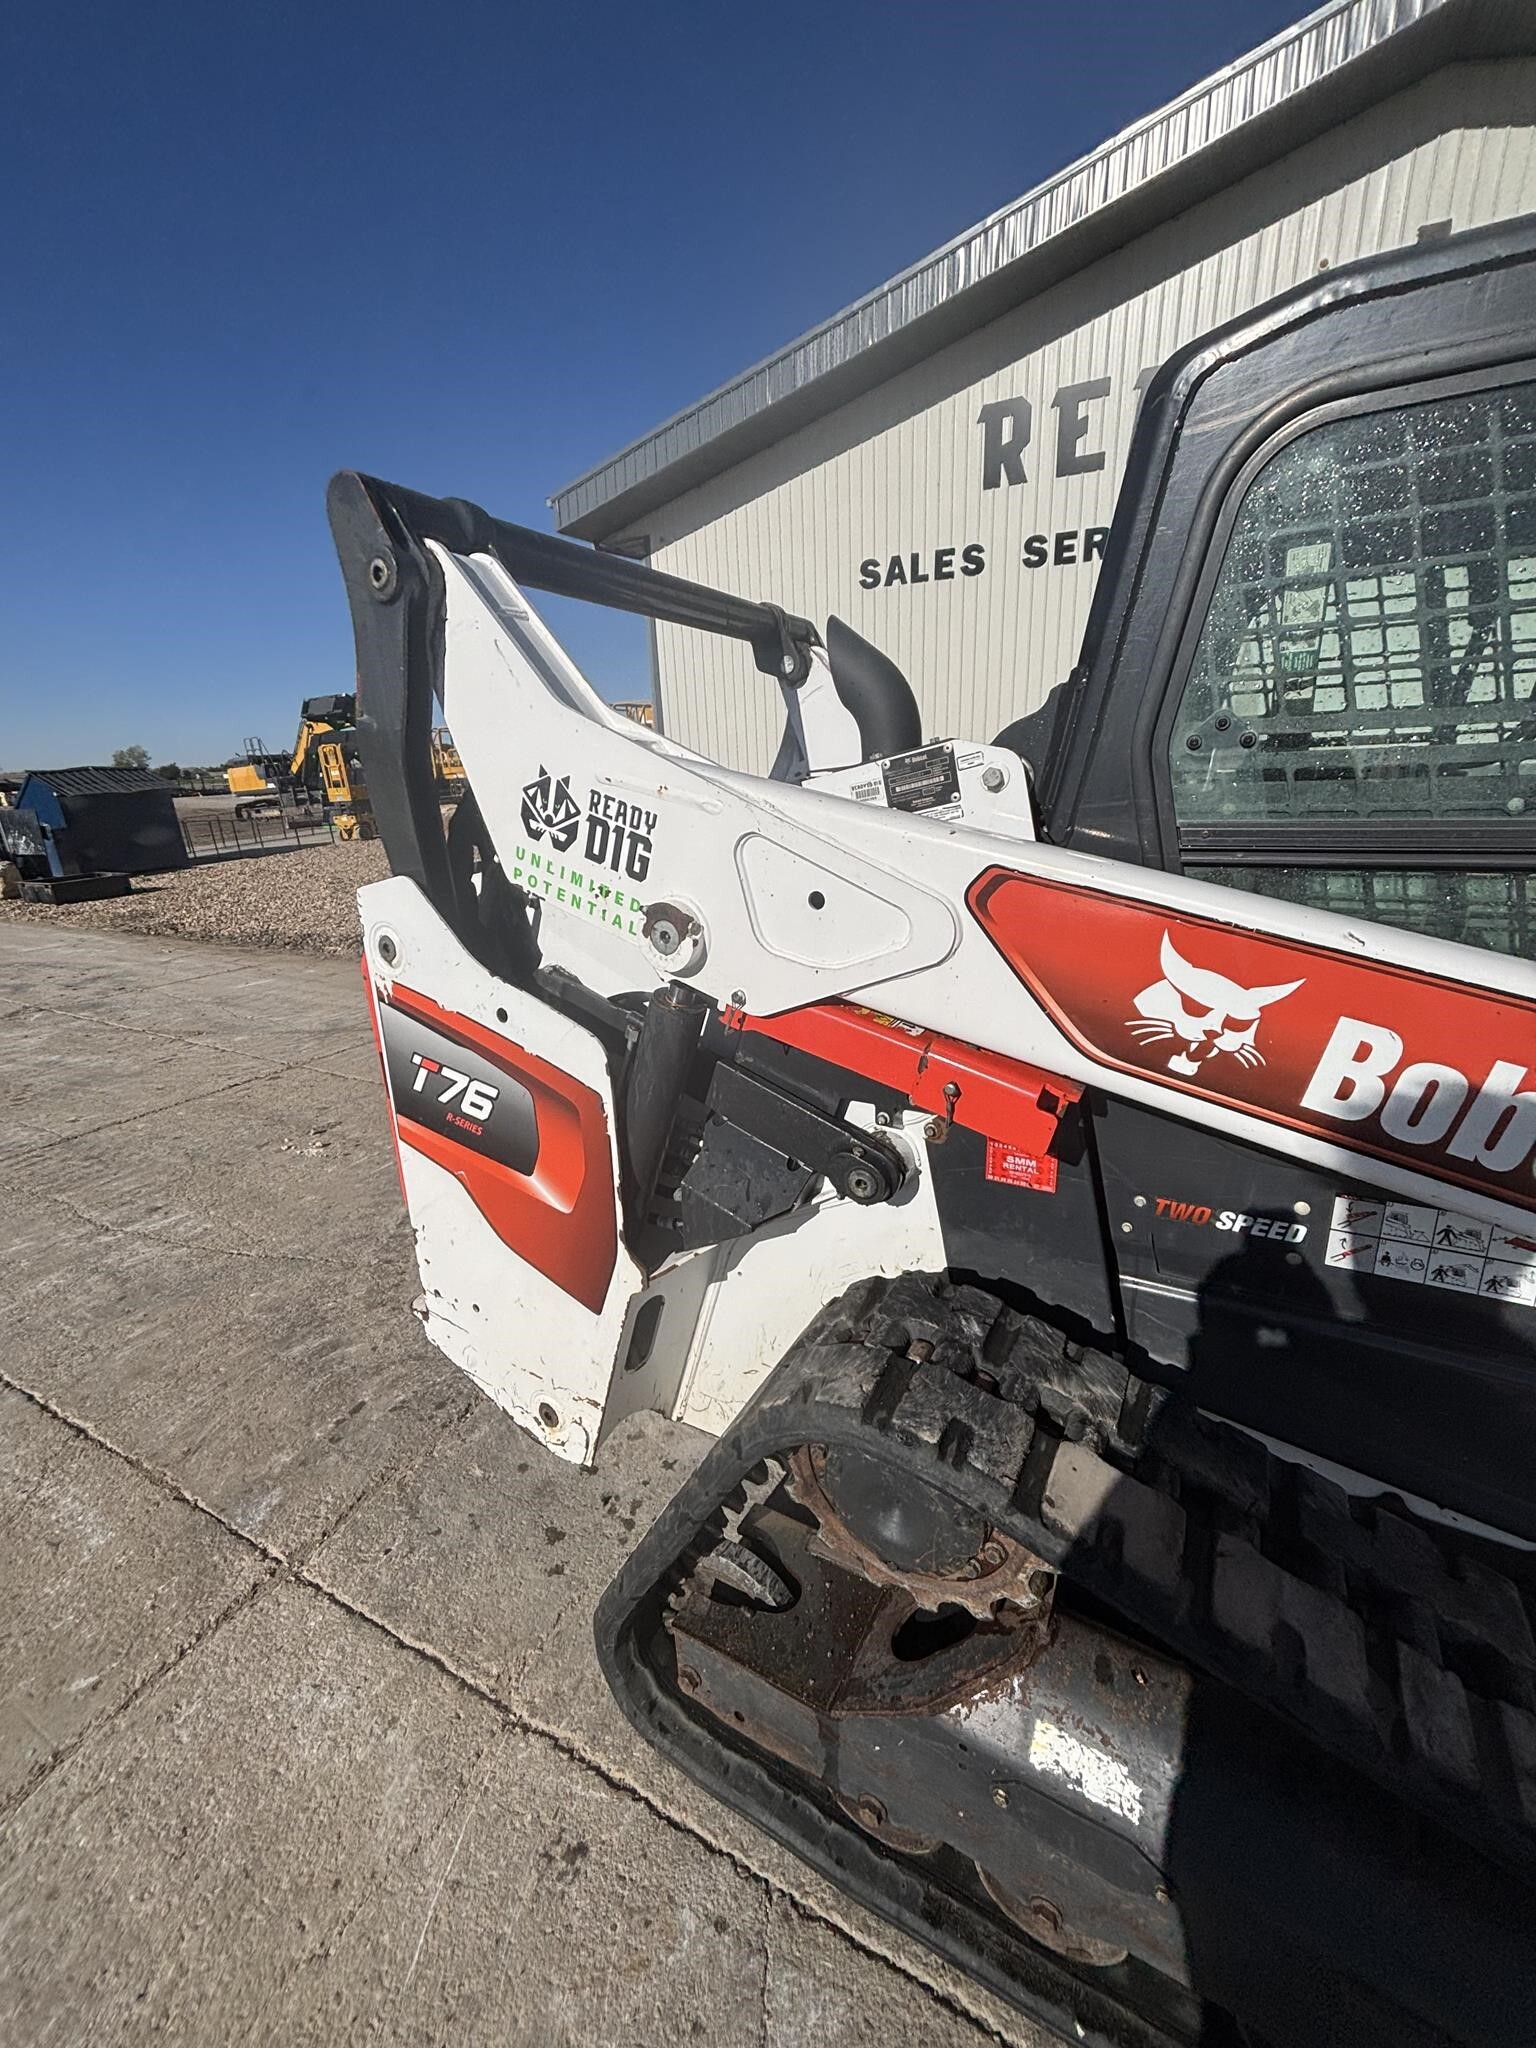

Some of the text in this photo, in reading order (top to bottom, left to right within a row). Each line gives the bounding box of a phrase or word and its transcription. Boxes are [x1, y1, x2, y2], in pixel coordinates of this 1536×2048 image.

[977, 366, 1160, 490] RE
[859, 544, 986, 590] SALES
[589, 789, 658, 835] READY
[584, 814, 653, 883] DIG
[513, 866, 638, 936] POTENTIAL
[515, 845, 642, 914] UNLIMITED
[411, 1052, 499, 1121] T76
[1301, 1015, 1536, 1180] Bob
[446, 1112, 483, 1136] R-SERIES
[1002, 1162, 1040, 1175] RENTAL
[1006, 1155, 1037, 1168] SMM
[1154, 1198, 1308, 1243] TWO SPEED
